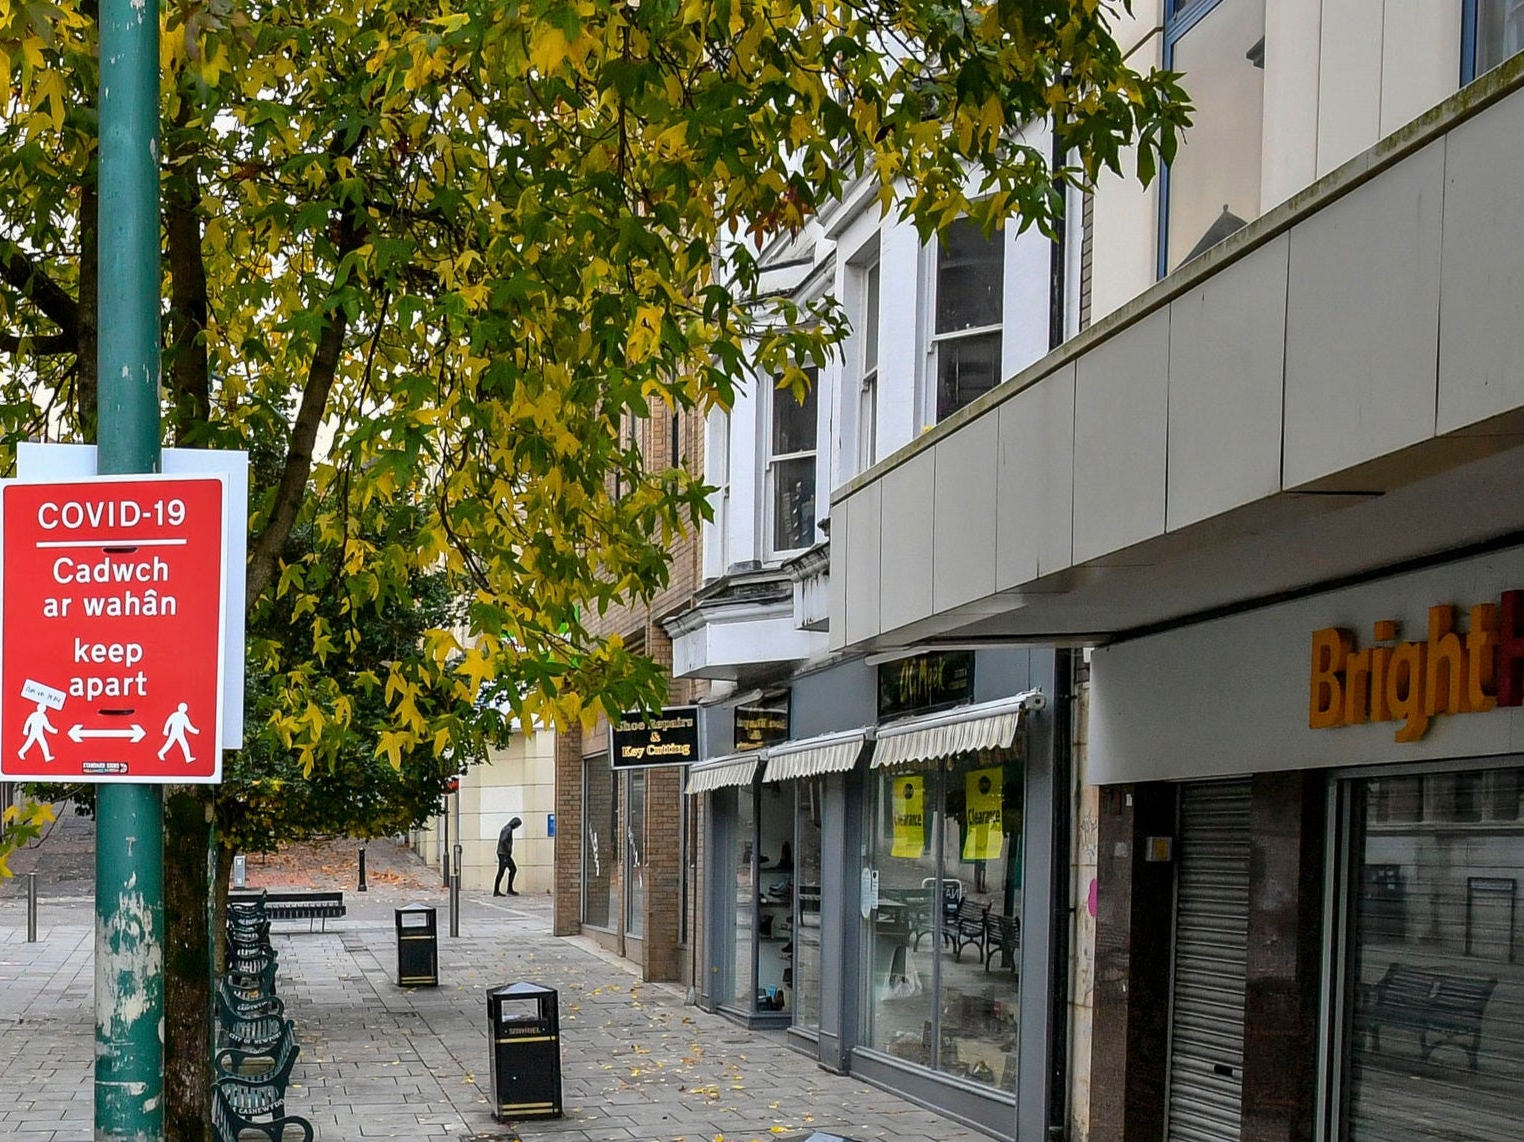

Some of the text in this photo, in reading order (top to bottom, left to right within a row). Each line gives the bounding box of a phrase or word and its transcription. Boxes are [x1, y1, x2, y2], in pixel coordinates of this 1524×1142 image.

[37, 499, 186, 529] COVID-19
[53, 556, 169, 584] Cadwch
[43, 589, 177, 617] ar wahân
[74, 637, 143, 667] keep
[69, 671, 148, 701] apart
[648, 717, 693, 731] Repairs
[650, 732, 661, 742] &
[622, 743, 690, 759] Key Cutting
[968, 809, 1000, 825] Clearance
